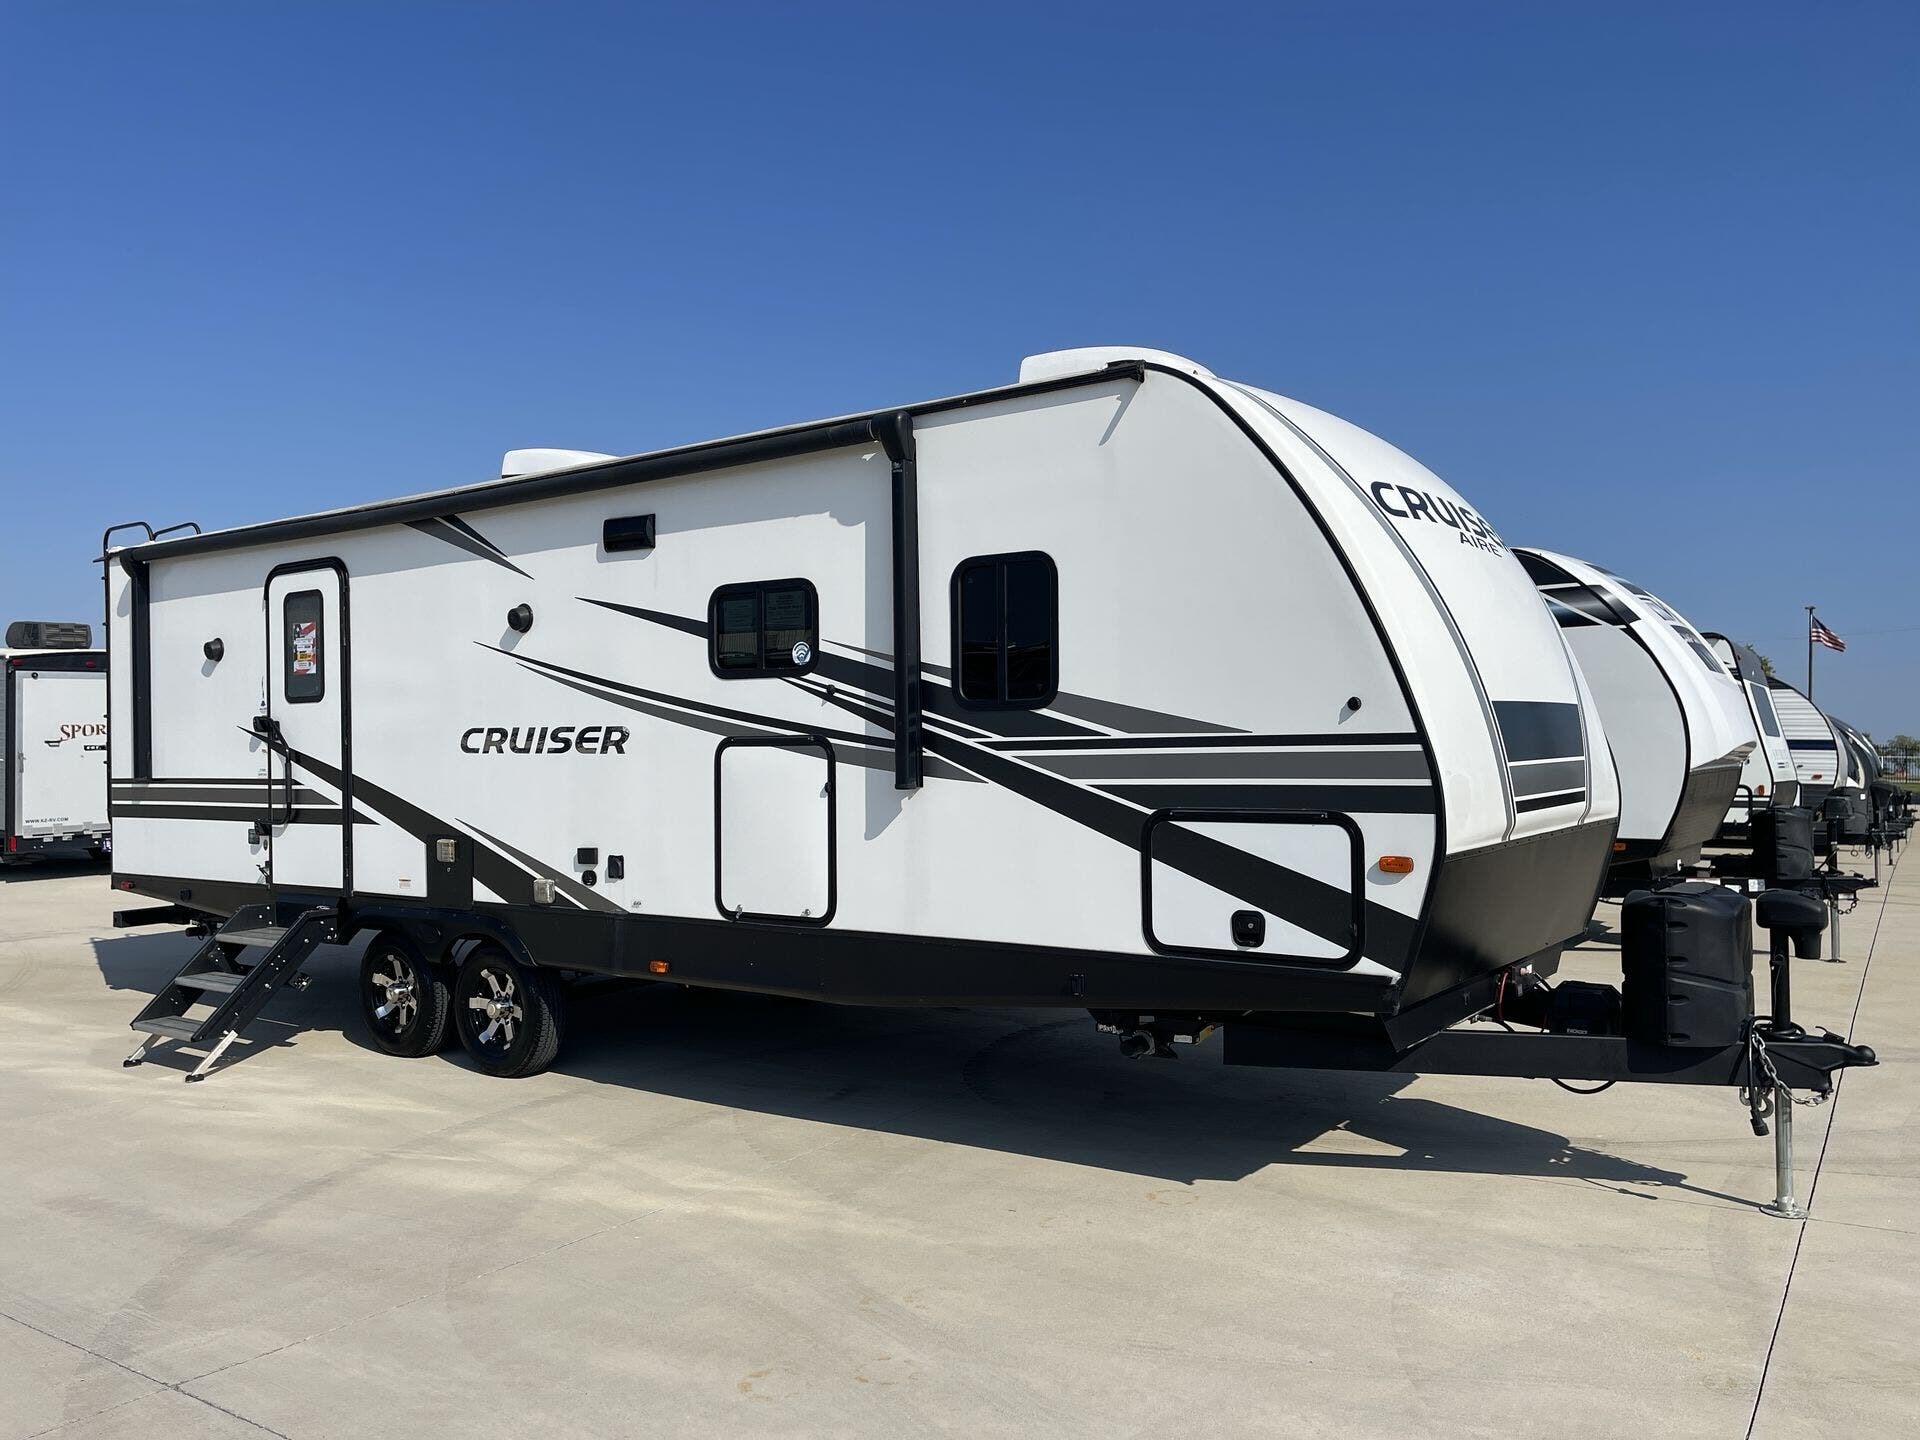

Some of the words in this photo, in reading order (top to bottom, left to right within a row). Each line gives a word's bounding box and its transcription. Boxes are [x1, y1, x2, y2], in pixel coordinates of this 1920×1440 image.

[1371, 481, 1509, 552] CRUISE
[1459, 532, 1503, 558] AIRE
[460, 726, 631, 755] CRUISER
